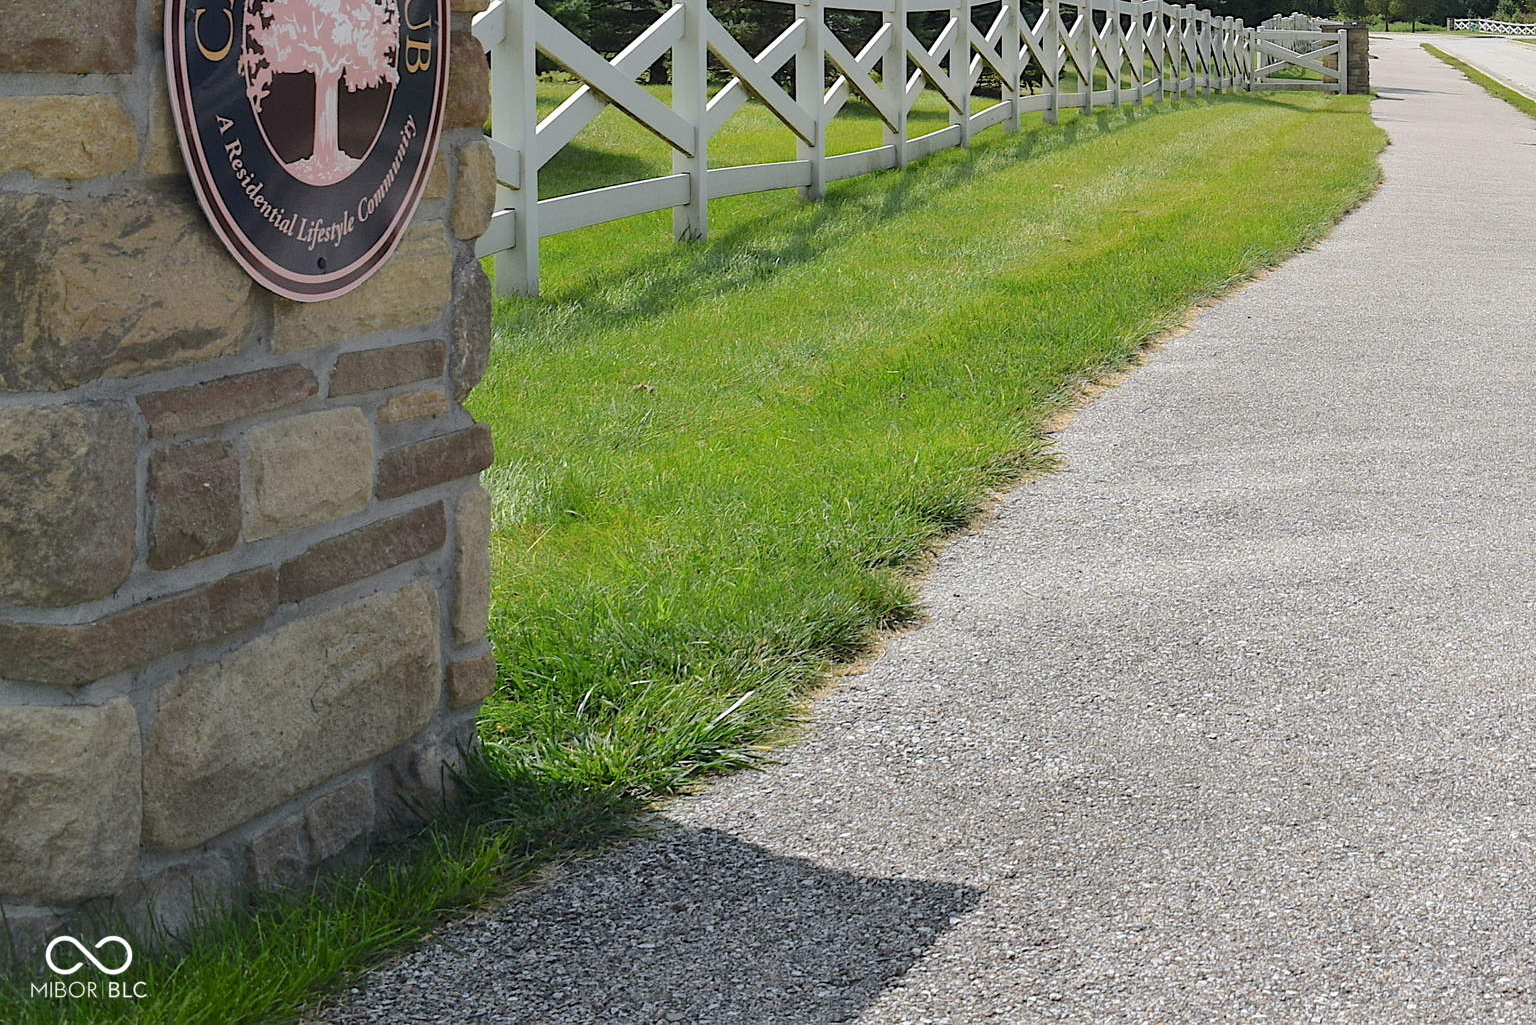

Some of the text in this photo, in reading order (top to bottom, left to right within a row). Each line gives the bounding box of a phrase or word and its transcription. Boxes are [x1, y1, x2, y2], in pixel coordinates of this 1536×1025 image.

[216, 115, 417, 250] A Residential Lifestyle Community
